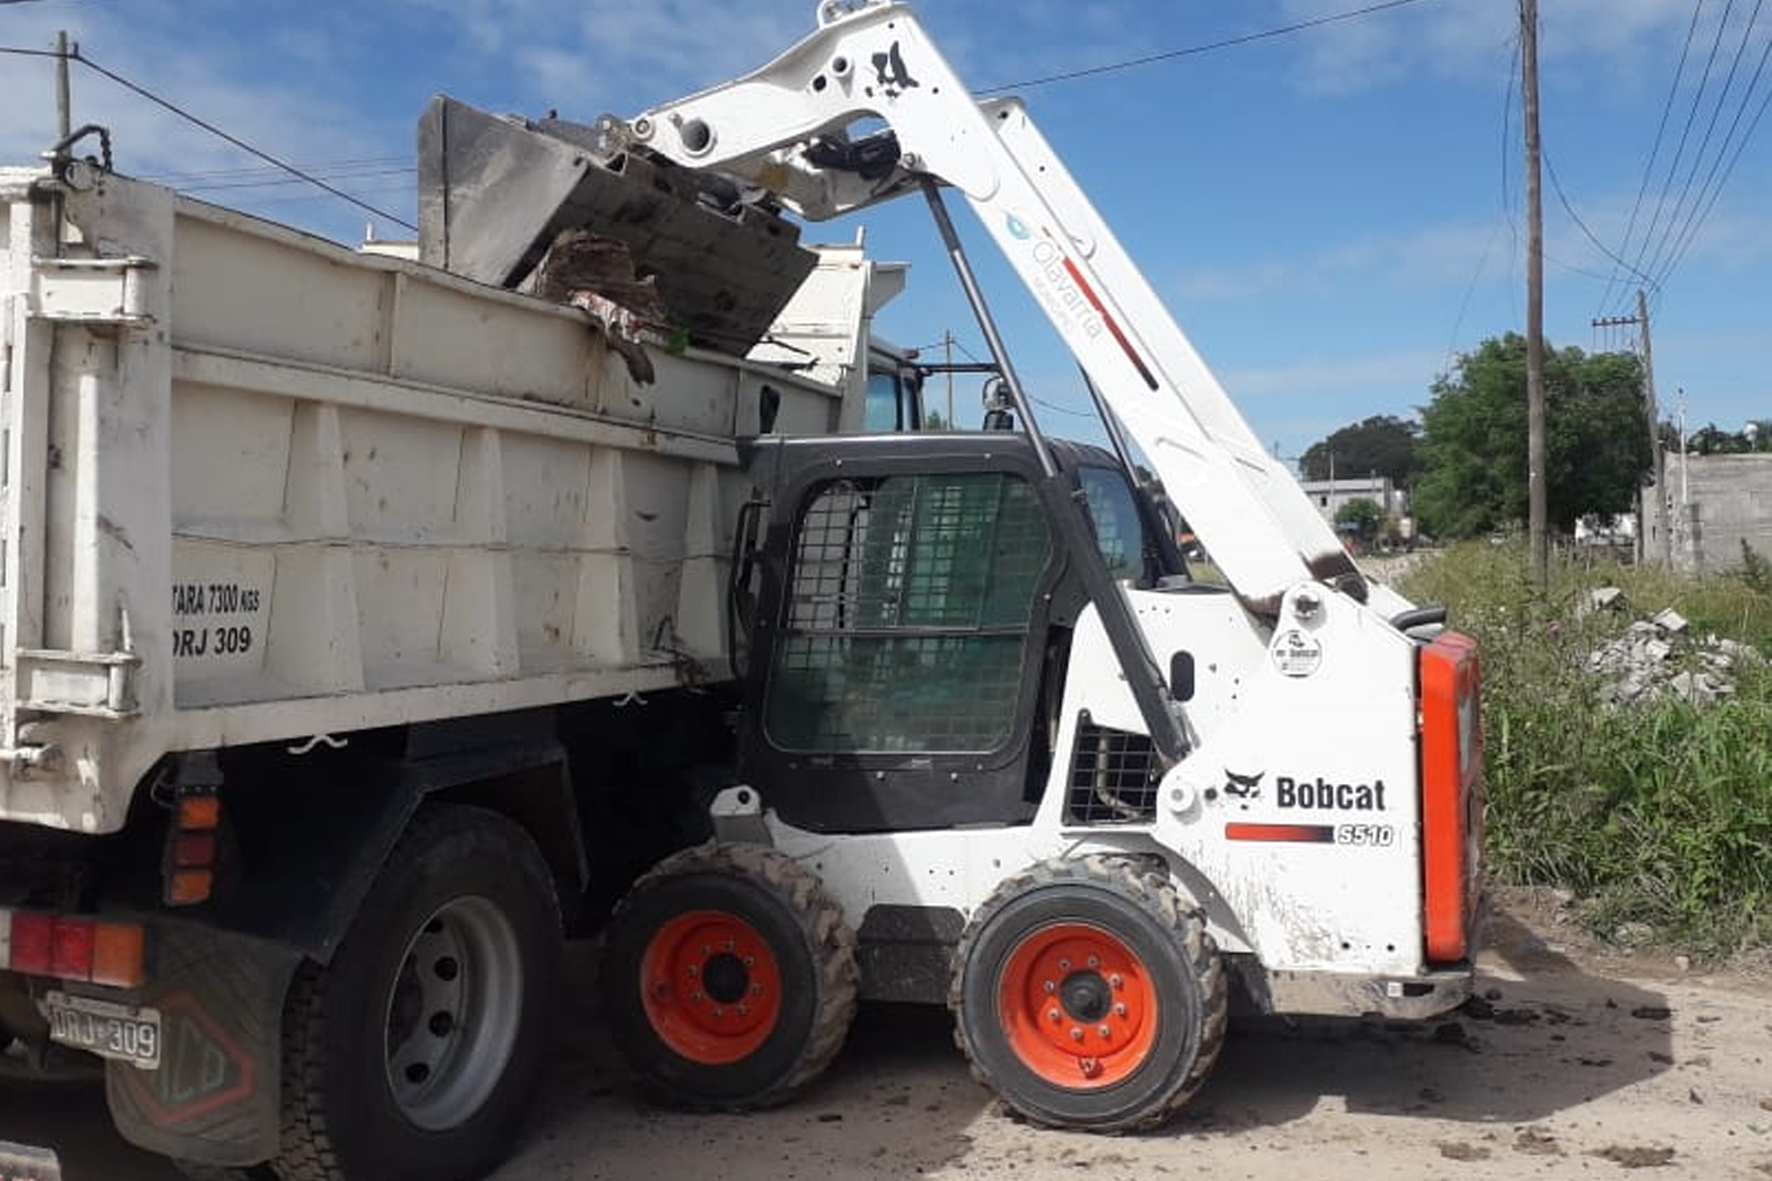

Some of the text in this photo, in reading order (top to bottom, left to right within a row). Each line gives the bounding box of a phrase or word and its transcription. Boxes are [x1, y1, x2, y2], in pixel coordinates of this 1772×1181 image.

[209, 584, 239, 613] 7300
[214, 625, 251, 655] 309
[1276, 776, 1386, 812] Bobcat
[1338, 824, 1395, 846] S510
[110, 1016, 156, 1058] 309
